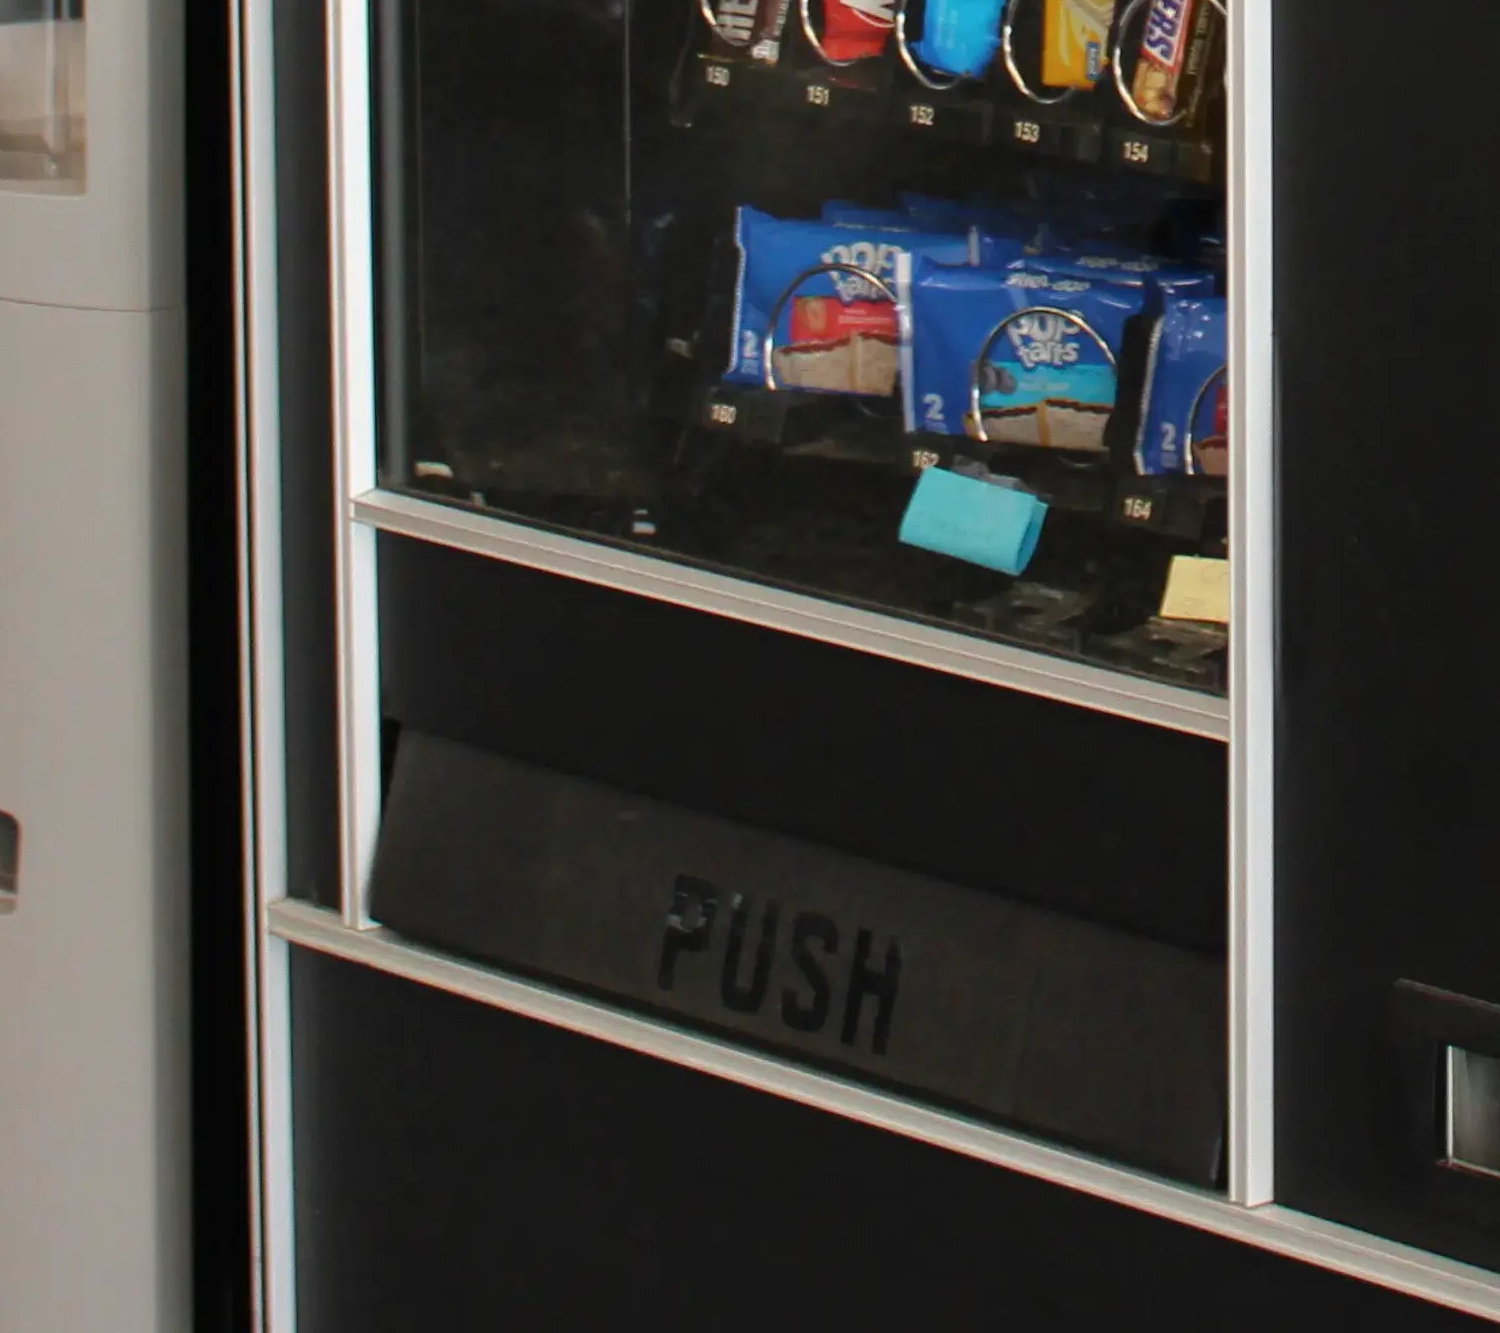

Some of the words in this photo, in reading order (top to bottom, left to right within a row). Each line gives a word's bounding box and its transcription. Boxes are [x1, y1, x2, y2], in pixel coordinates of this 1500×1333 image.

[706, 66, 729, 87] 150
[807, 86, 830, 106] 151
[910, 106, 935, 126] 152
[1016, 122, 1040, 142] 153
[1124, 142, 1149, 162] 154
[743, 331, 757, 359] 2
[711, 404, 736, 425] 160
[924, 393, 944, 421] 2
[1160, 423, 1175, 451] 2
[913, 450, 939, 469] 162
[1123, 498, 1151, 519] 164
[658, 873, 904, 1055] PUSH
